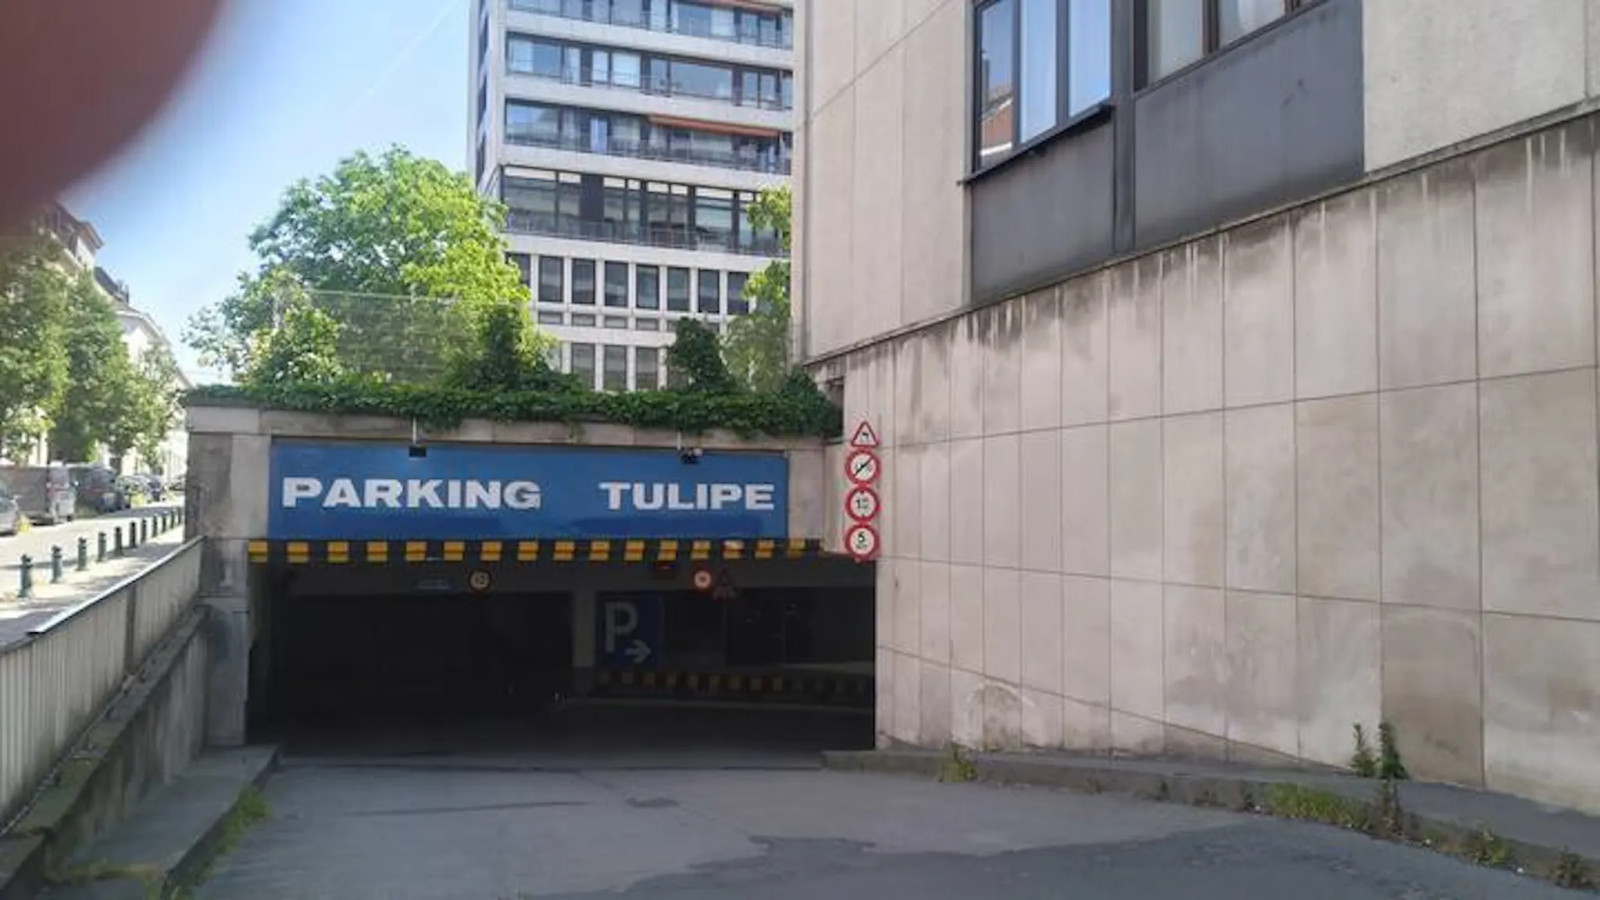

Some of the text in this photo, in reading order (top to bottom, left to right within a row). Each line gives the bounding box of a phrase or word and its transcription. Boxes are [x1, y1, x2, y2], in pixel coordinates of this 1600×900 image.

[281, 476, 775, 511] PARKING TULIPE
[605, 601, 638, 653] P
